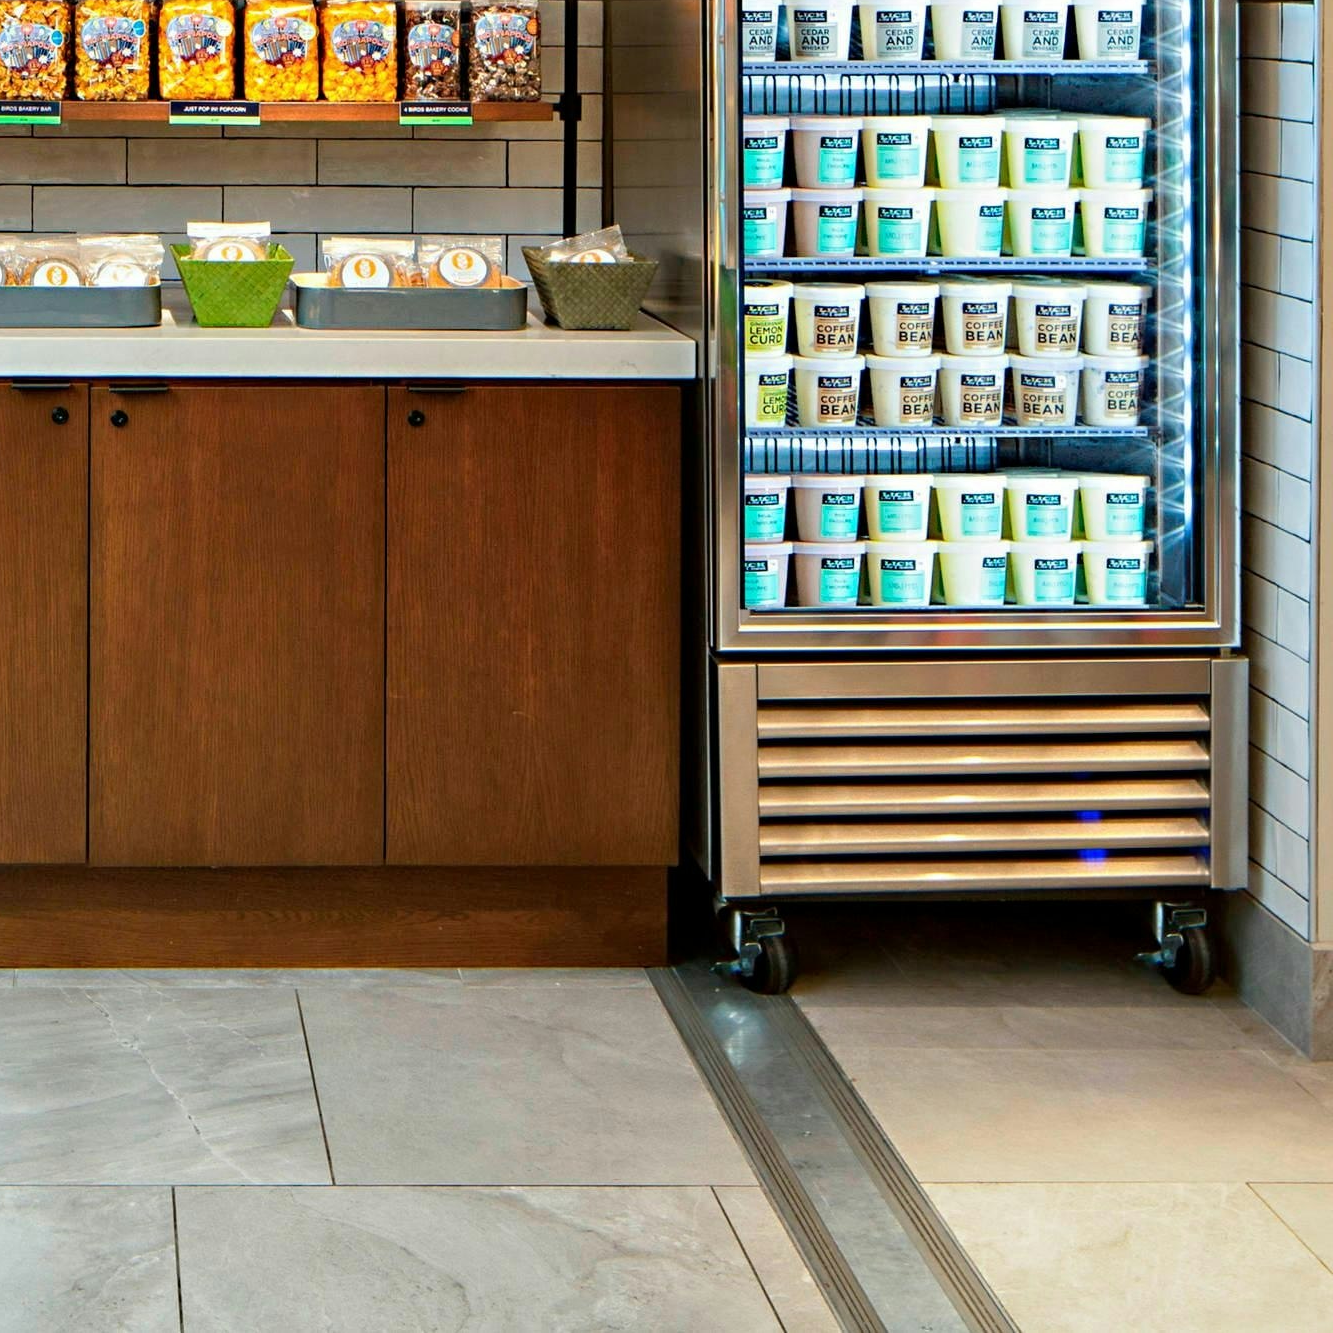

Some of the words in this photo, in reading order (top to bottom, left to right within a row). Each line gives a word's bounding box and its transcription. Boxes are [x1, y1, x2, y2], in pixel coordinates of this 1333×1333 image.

[801, 36, 830, 46] AND
[750, 325, 783, 334] LEMON
[1038, 324, 1077, 332] COFFEE
[750, 335, 782, 345] CURD
[1038, 333, 1076, 344] BEAN
[1023, 394, 1063, 403] COFFEE
[1023, 404, 1064, 415] BEAN
